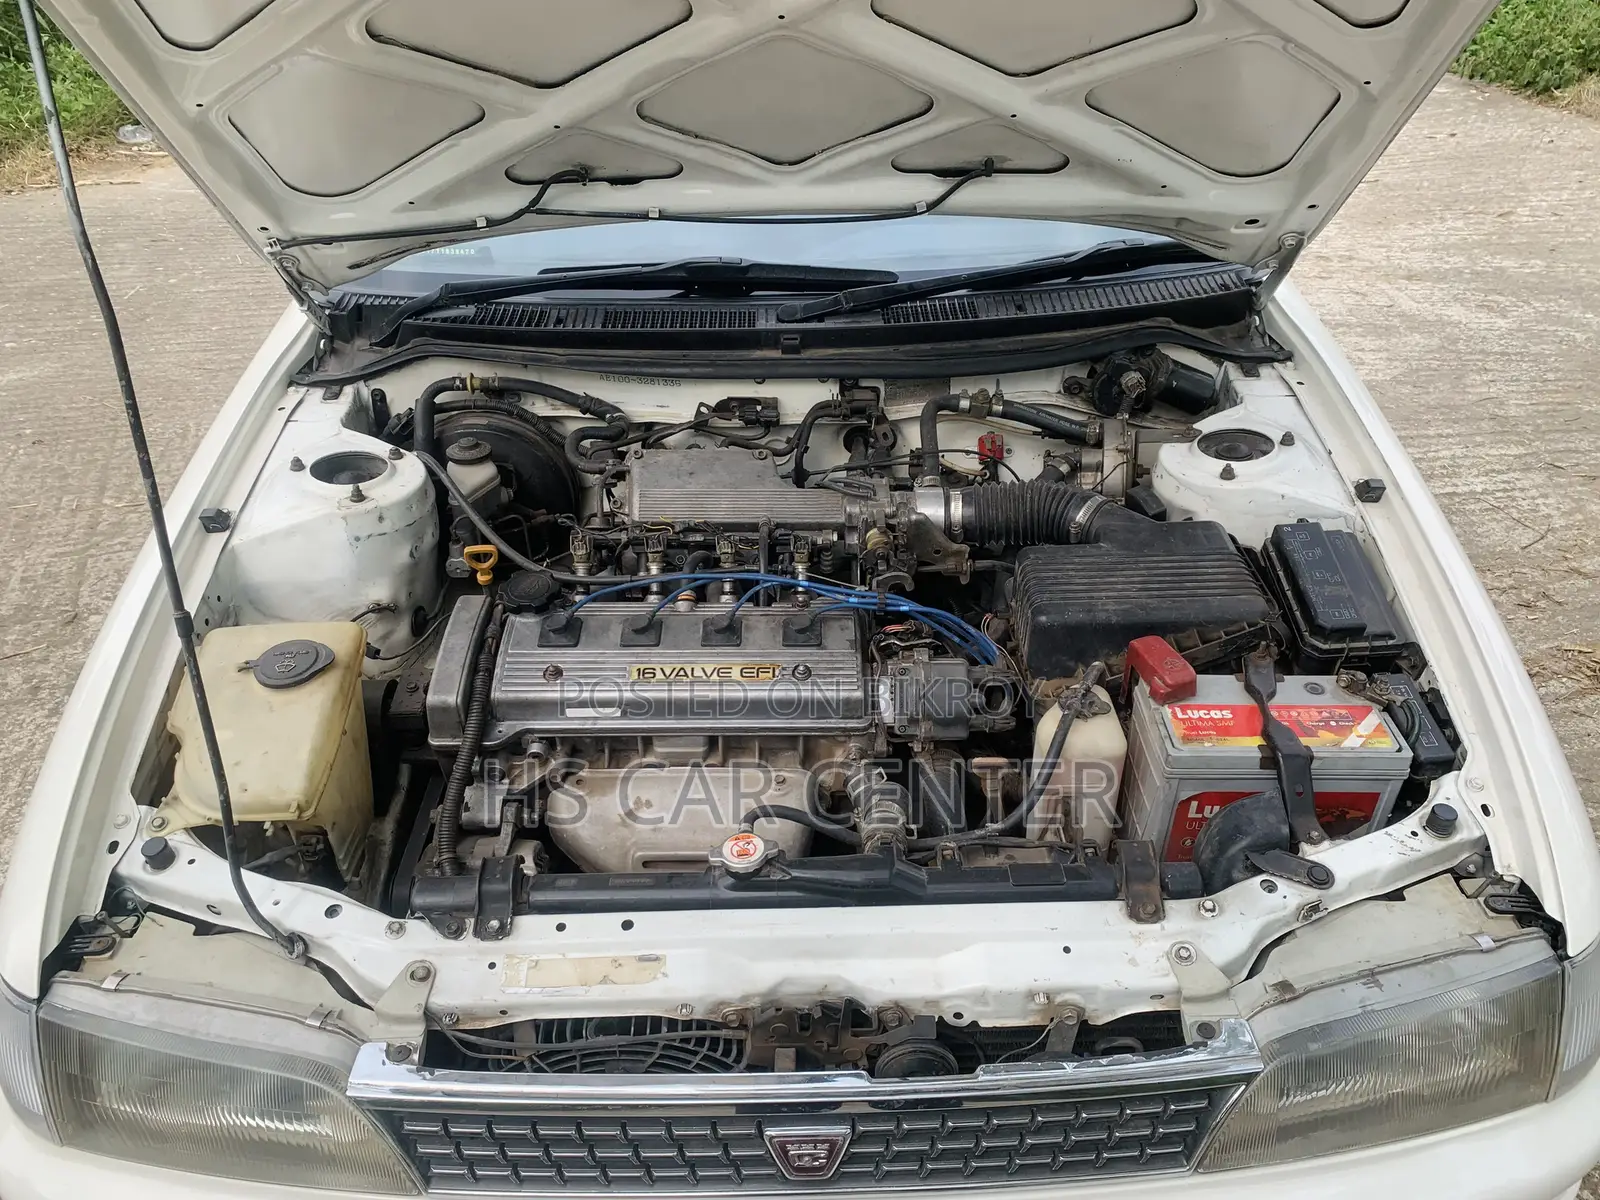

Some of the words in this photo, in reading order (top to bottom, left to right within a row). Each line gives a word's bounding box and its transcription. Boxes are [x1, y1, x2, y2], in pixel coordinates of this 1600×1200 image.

[636, 667, 657, 679] 16
[659, 667, 733, 679] VALVE
[739, 667, 776, 679] EFI
[1174, 706, 1233, 719] Lucas
